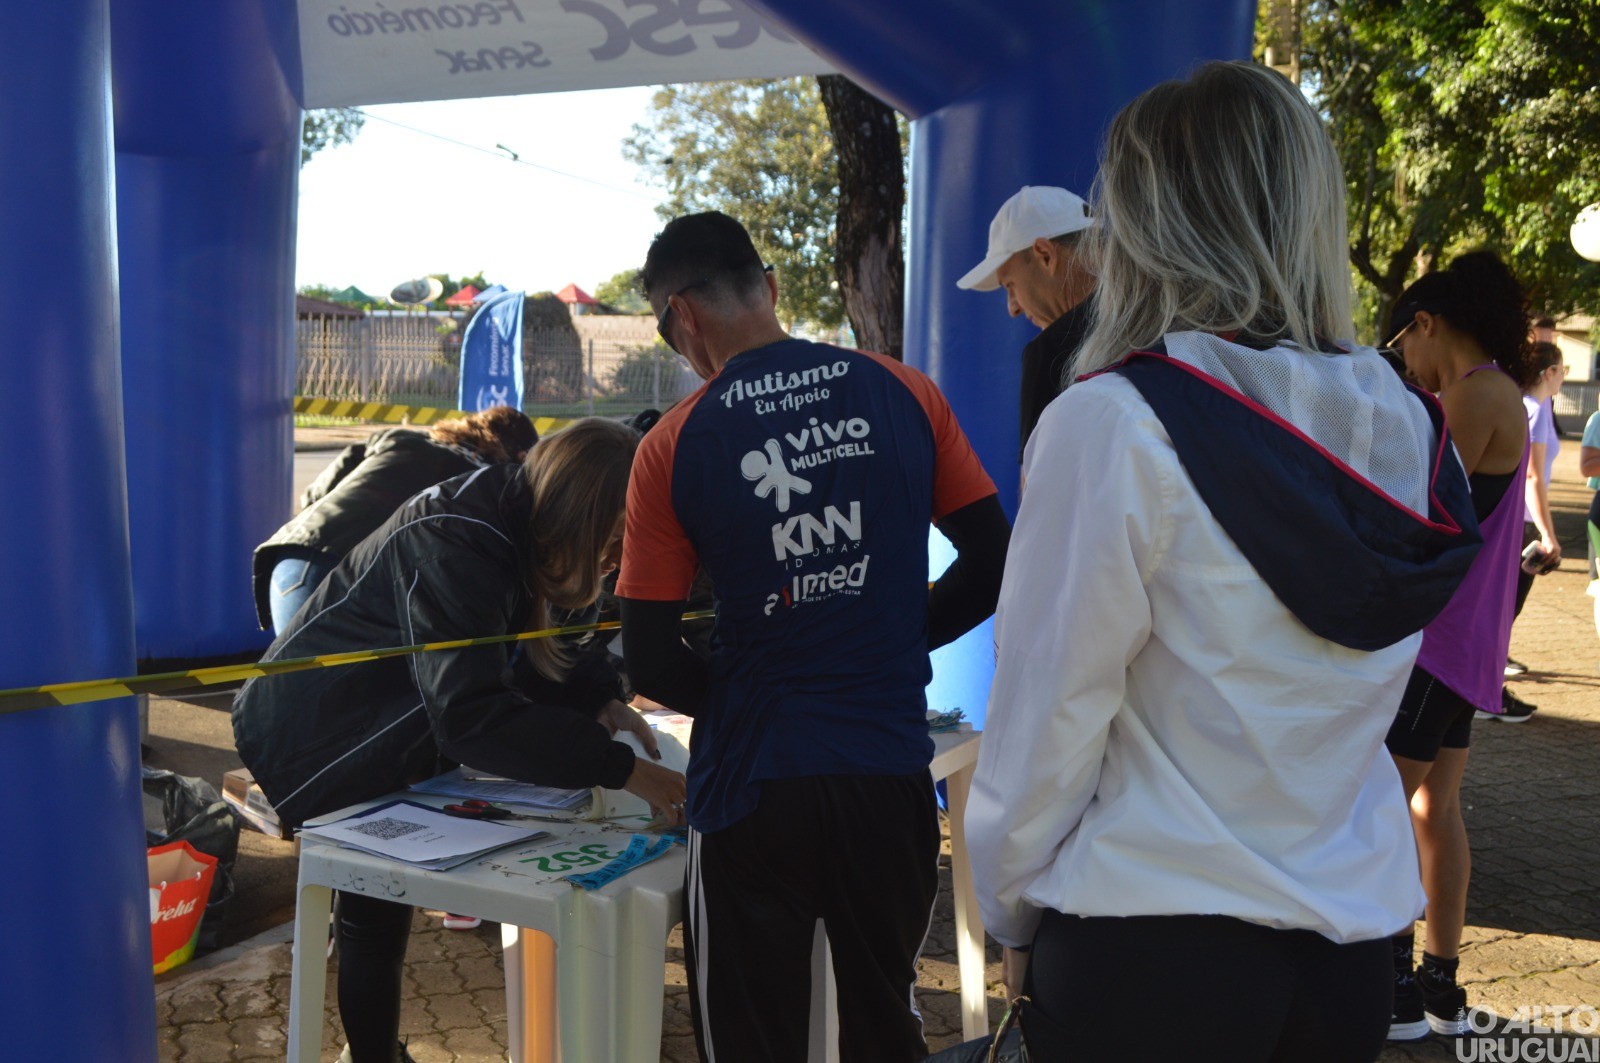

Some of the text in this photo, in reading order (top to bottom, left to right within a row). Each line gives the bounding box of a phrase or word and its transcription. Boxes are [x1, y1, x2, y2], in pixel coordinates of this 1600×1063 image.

[720, 361, 850, 408] Autismo
[755, 387, 831, 415] Eu Apoio
[784, 417, 871, 452] vivo
[790, 442, 875, 471] MULTICELL
[771, 501, 862, 561] KNN
[518, 844, 626, 873] 352
